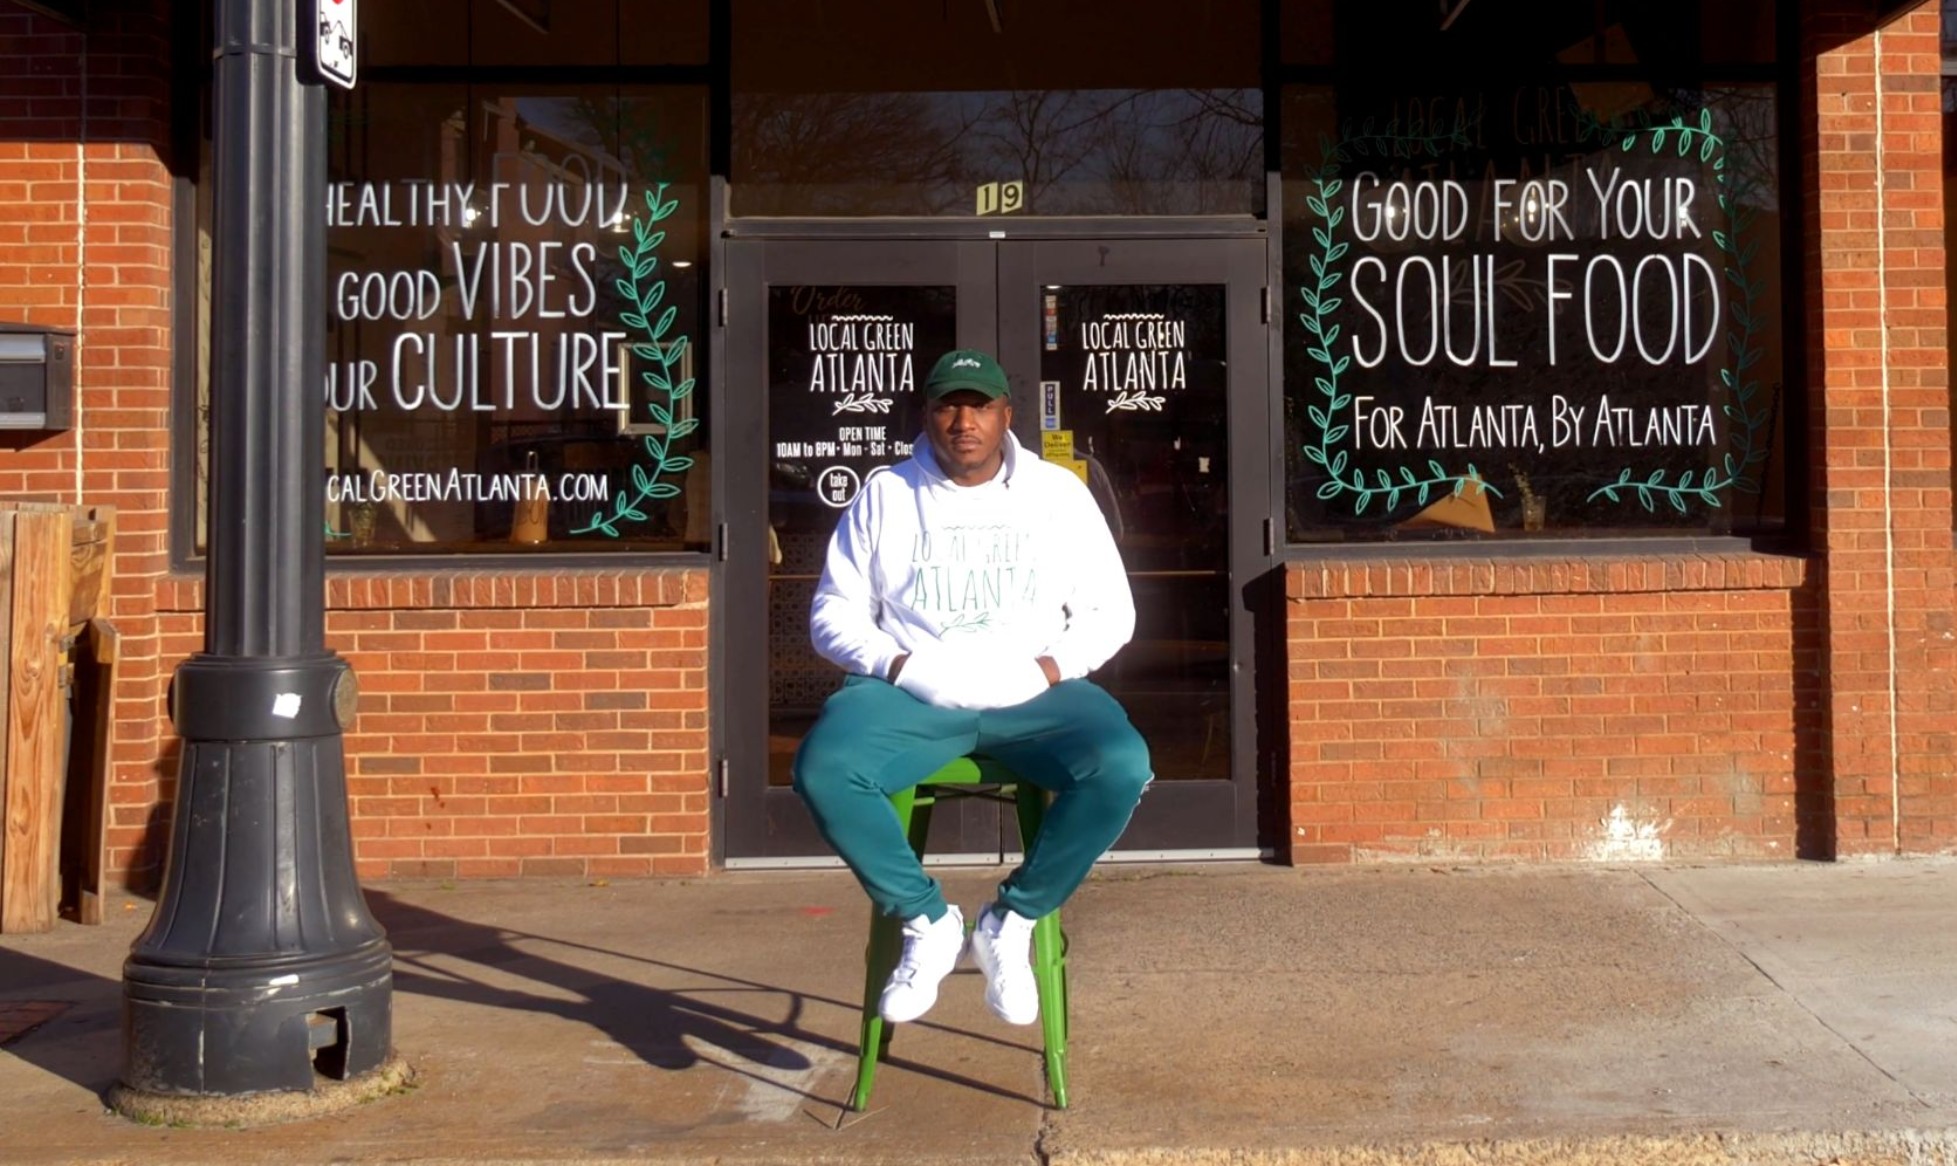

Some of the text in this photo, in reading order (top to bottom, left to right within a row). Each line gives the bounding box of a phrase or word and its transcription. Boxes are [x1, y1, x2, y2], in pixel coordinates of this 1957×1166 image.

[984, 184, 1020, 211] 19
[1494, 178, 1574, 242] FOR
[338, 242, 597, 320] GOOD VIBES
[1350, 253, 1720, 369] SOUL FOOD
[809, 322, 914, 351] LOCAL GREEN
[1082, 321, 1131, 350] LOCAL
[1136, 320, 1185, 349] GREEN
[324, 331, 630, 412] UR CULTURE
[809, 352, 915, 393] ATLANTA
[1083, 350, 1187, 391] ATLANTA
[777, 443, 801, 457] 10AM
[803, 443, 813, 457] to
[842, 442, 861, 456] Mon
[871, 441, 885, 455] Sat
[839, 426, 887, 441] OPEN TIME
[829, 473, 848, 487] take
[831, 488, 847, 502] out
[910, 566, 1038, 612] ATLANTA
